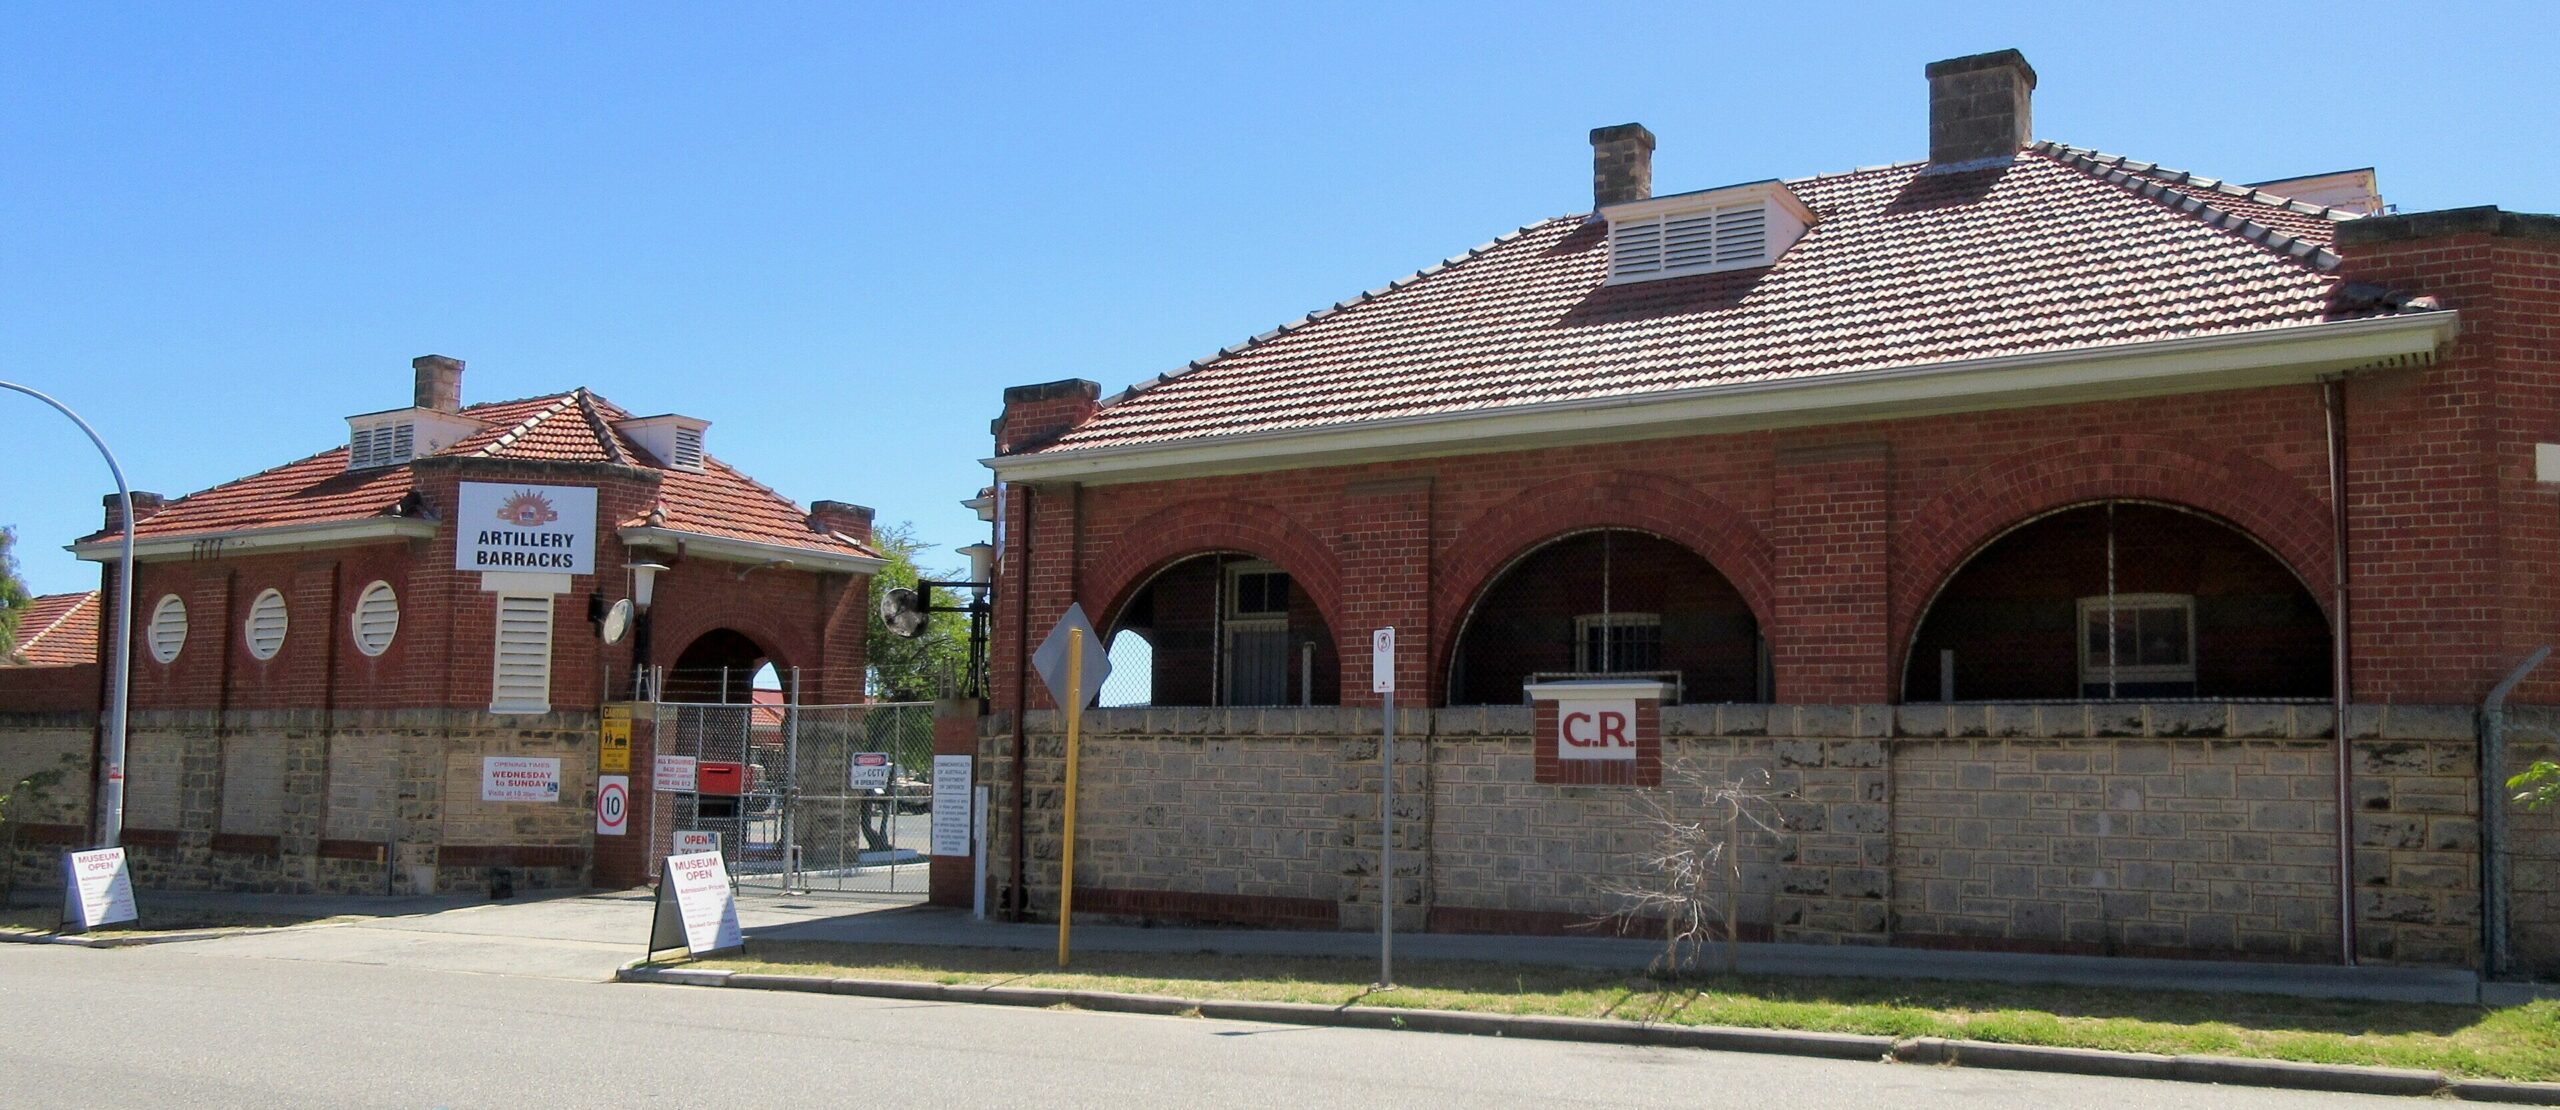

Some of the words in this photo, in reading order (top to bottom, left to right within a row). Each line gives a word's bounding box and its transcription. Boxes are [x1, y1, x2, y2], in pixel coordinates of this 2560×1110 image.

[478, 531, 574, 548] ARTILLERY
[477, 551, 574, 568] BARRACKS
[1563, 711, 1635, 748] C.R.
[492, 771, 552, 779] WEDNESDAY
[867, 769, 885, 777] CCTV
[606, 797, 620, 815] 10
[685, 835, 707, 845] OPEN
[79, 852, 120, 864] MUSEUM
[675, 857, 718, 871] MUSEUM
[88, 862, 114, 871] OPEN
[686, 869, 713, 881] OPEN
